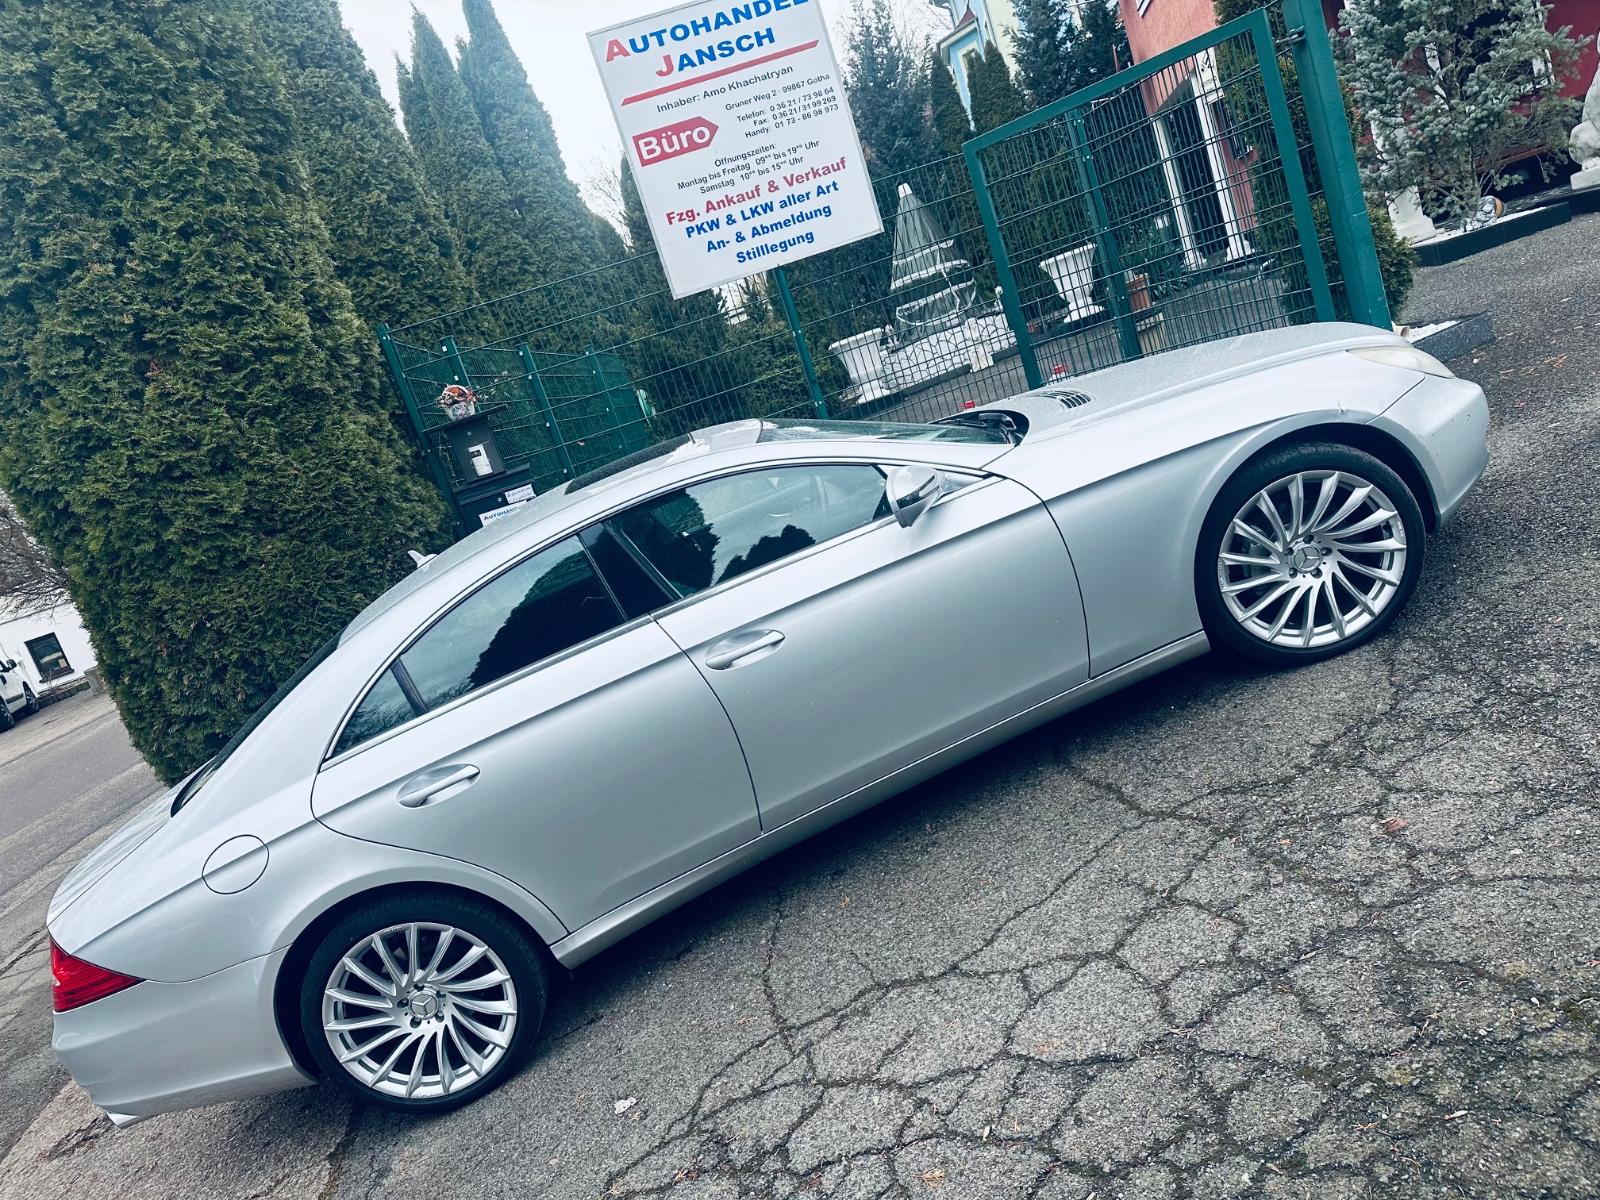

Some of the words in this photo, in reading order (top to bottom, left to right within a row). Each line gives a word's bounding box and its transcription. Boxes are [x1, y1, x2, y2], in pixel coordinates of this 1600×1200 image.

[655, 27, 776, 77] JANSCH
[736, 109, 767, 122] Telefon:
[744, 126, 772, 139] Handy:
[638, 125, 711, 160] Büro
[665, 208, 701, 226] Fzg.
[705, 184, 761, 214] Ankauf
[767, 179, 780, 193] &
[782, 156, 846, 188] Verkauf
[699, 178, 736, 194] Samstag
[757, 167, 770, 176] bis
[788, 156, 804, 166] Uhr
[685, 217, 720, 239] PKW
[725, 213, 738, 226] &
[740, 200, 774, 222] LKW
[778, 191, 811, 209] aller
[816, 180, 839, 198] Art
[707, 239, 731, 253] An-
[735, 231, 747, 244] &
[751, 204, 832, 239] Abmeldung
[735, 231, 815, 264] Stilllegung
